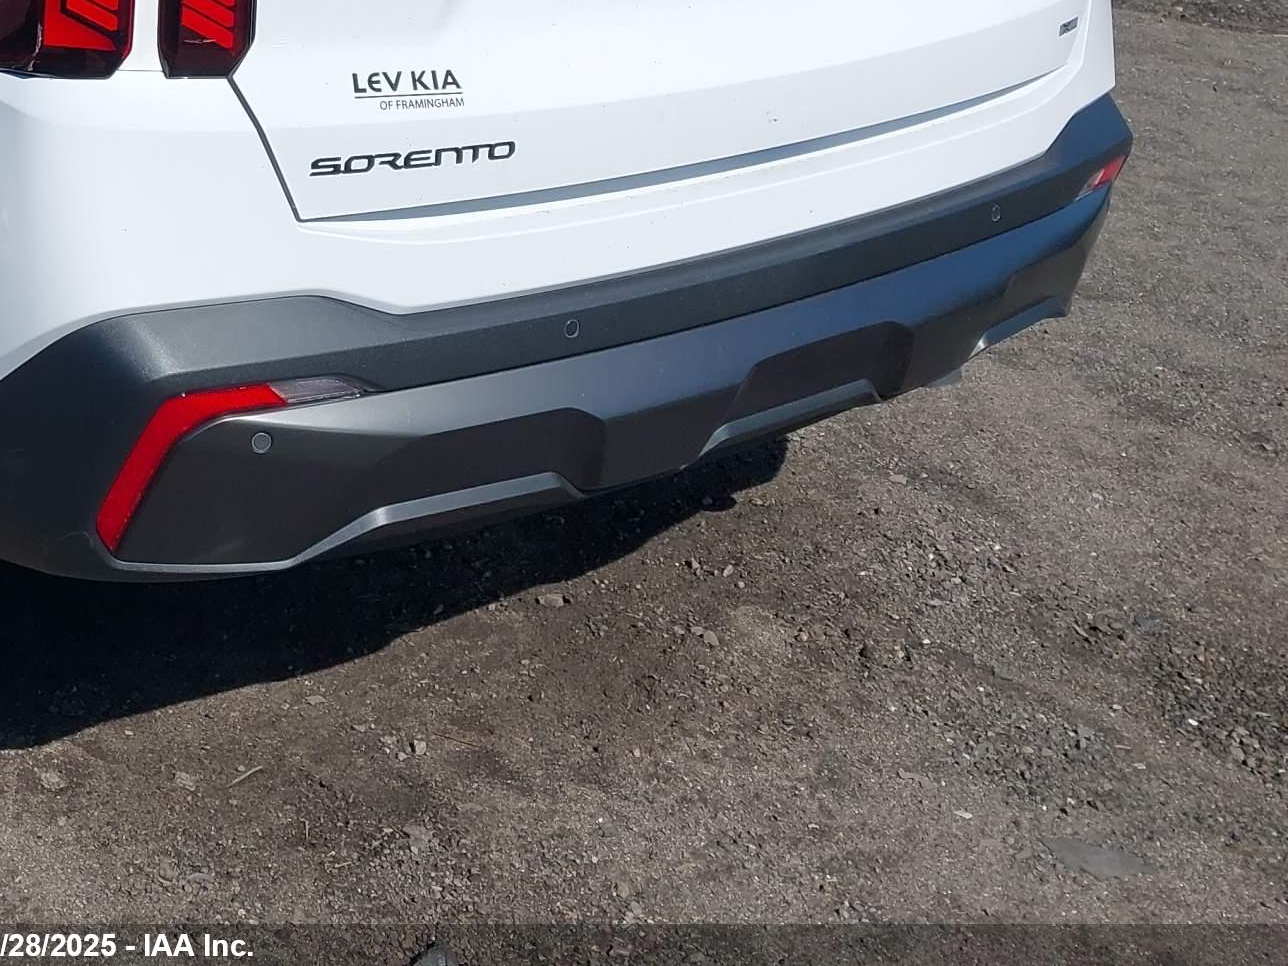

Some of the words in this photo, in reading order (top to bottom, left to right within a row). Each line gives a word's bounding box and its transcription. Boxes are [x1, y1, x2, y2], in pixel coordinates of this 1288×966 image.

[352, 71, 402, 94] LEV
[410, 69, 462, 91] KIA
[379, 100, 394, 111] OF
[396, 97, 465, 110] FRAMINGHAM
[309, 140, 516, 177] SORENTO
